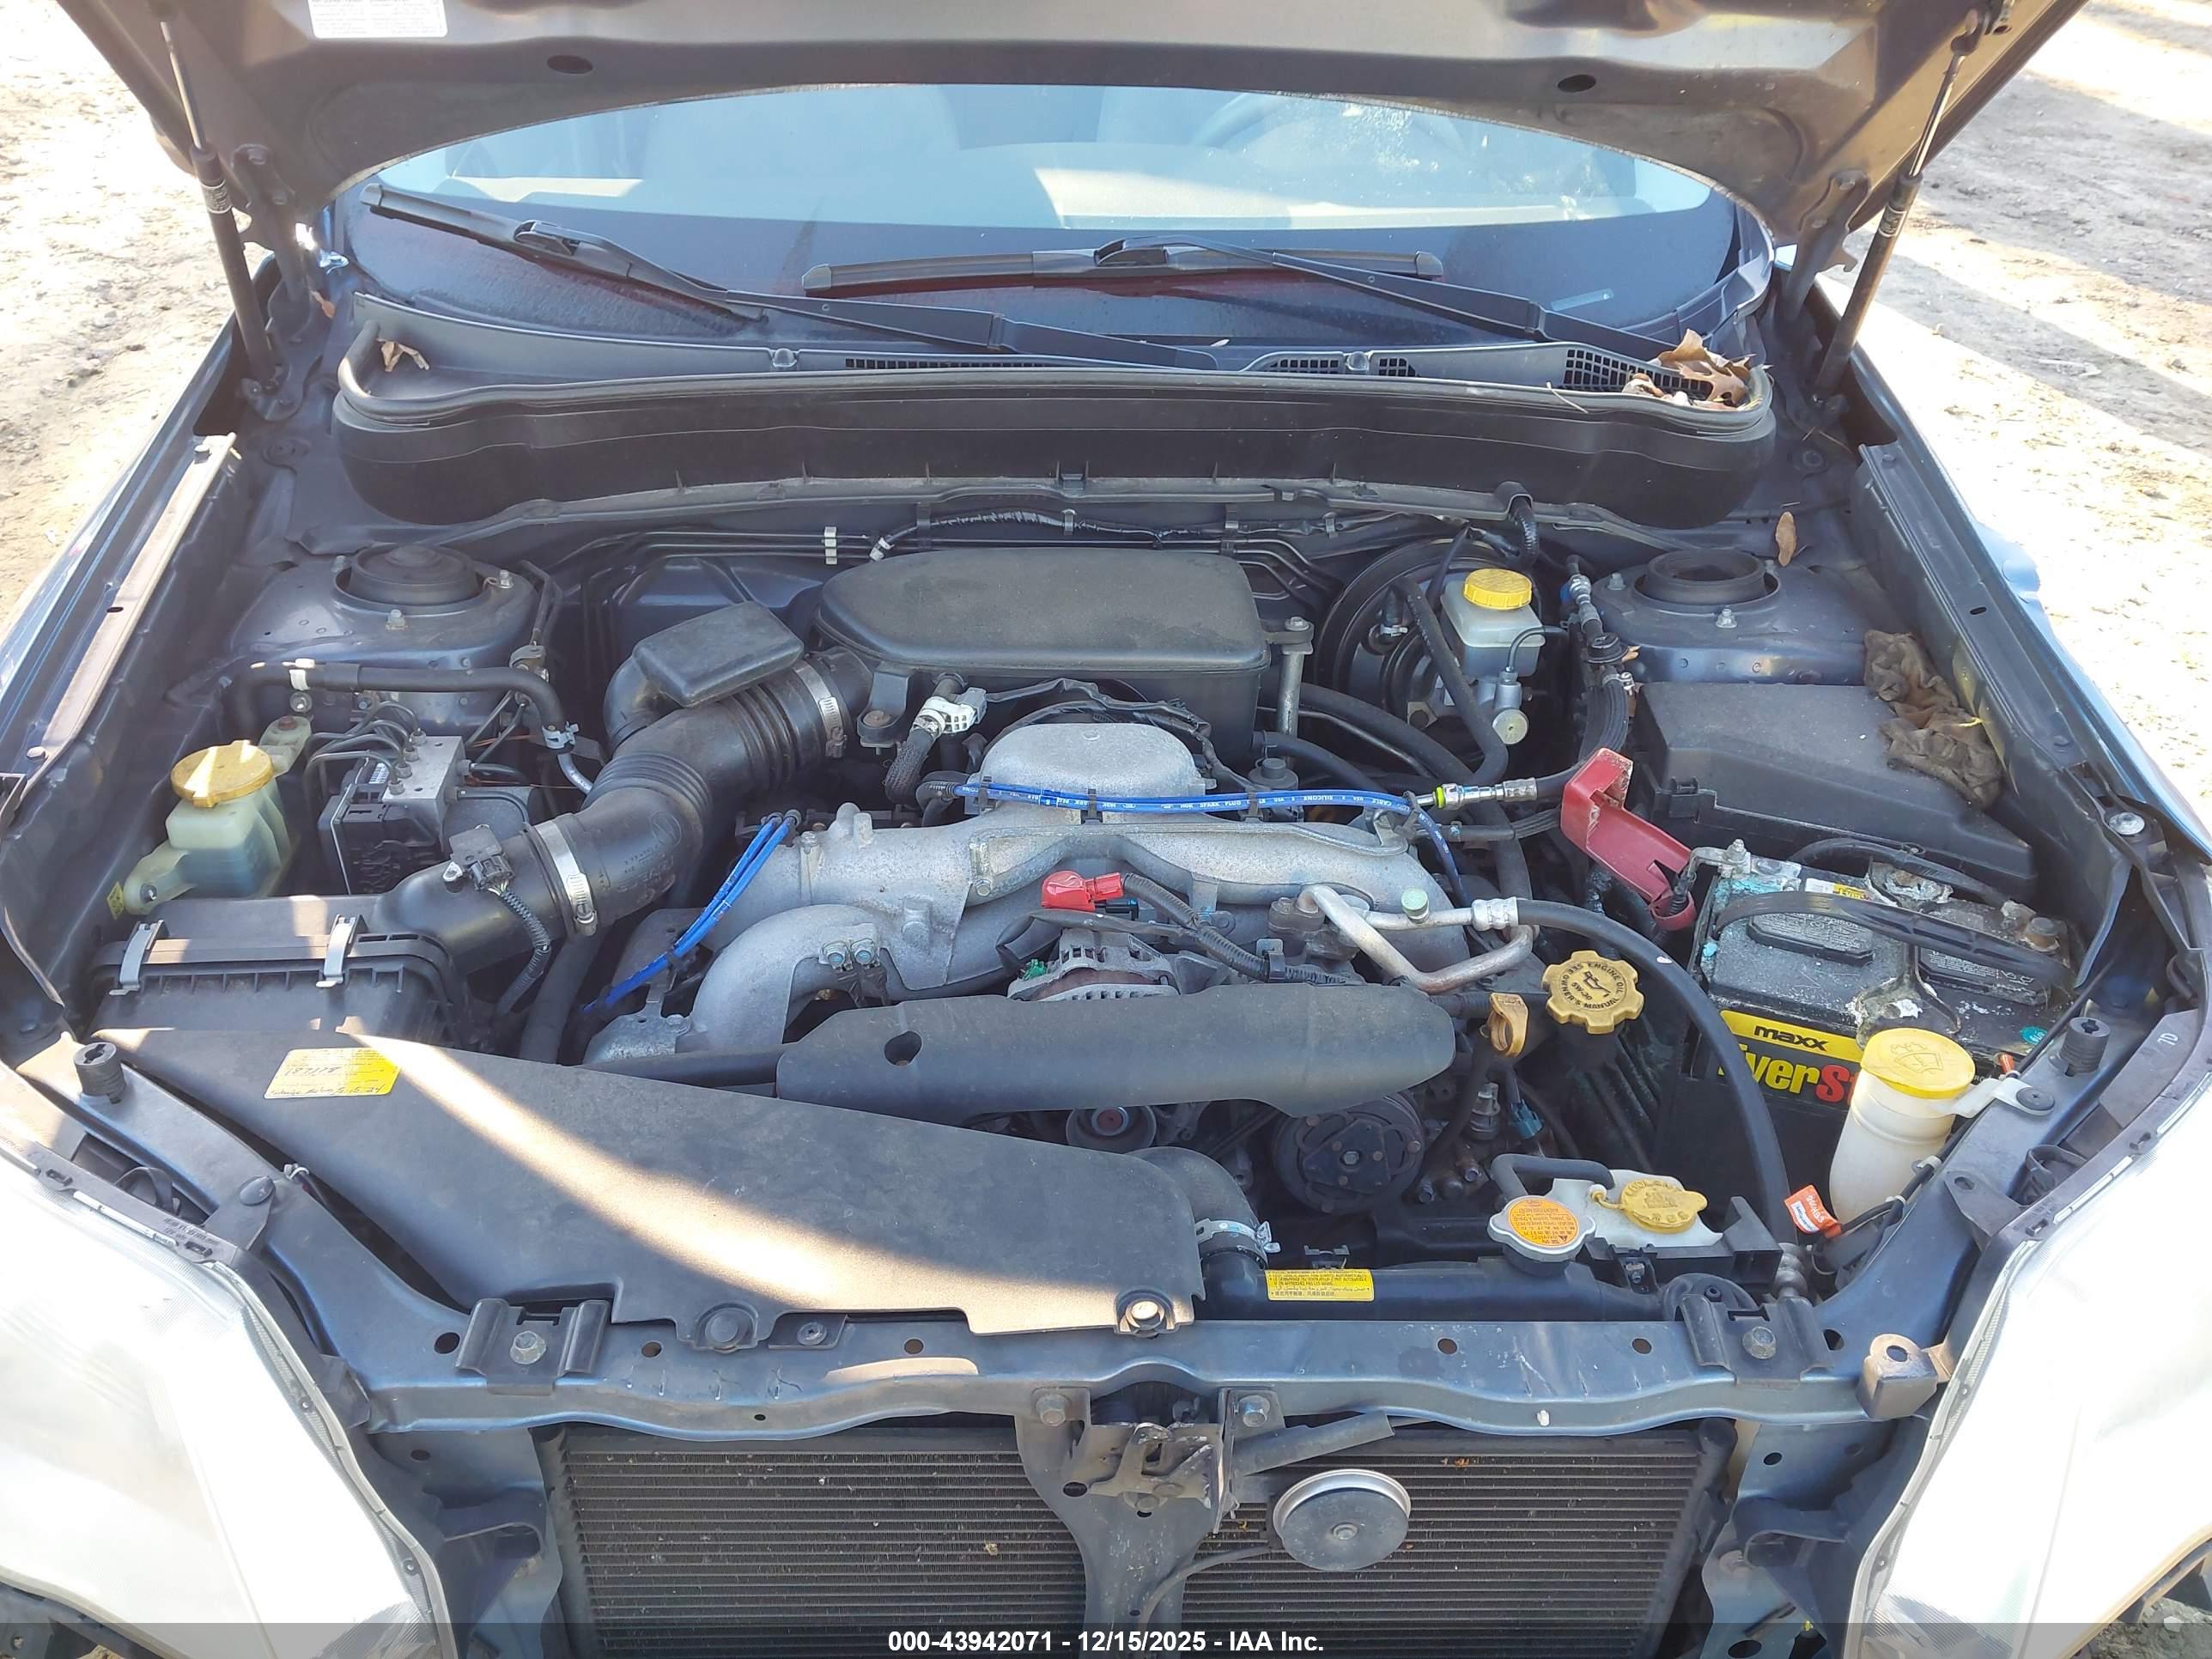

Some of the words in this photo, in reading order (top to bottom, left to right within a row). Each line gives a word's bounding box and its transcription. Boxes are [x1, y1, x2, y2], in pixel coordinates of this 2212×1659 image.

[1568, 963, 1583, 975] SEE
[1589, 963, 1621, 981] ENGINE
[1615, 981, 1625, 996] OIL
[1561, 974, 1582, 1006] OWNER'S
[1583, 998, 1620, 1009] MANUAL
[1754, 1025, 1829, 1052] maxx
